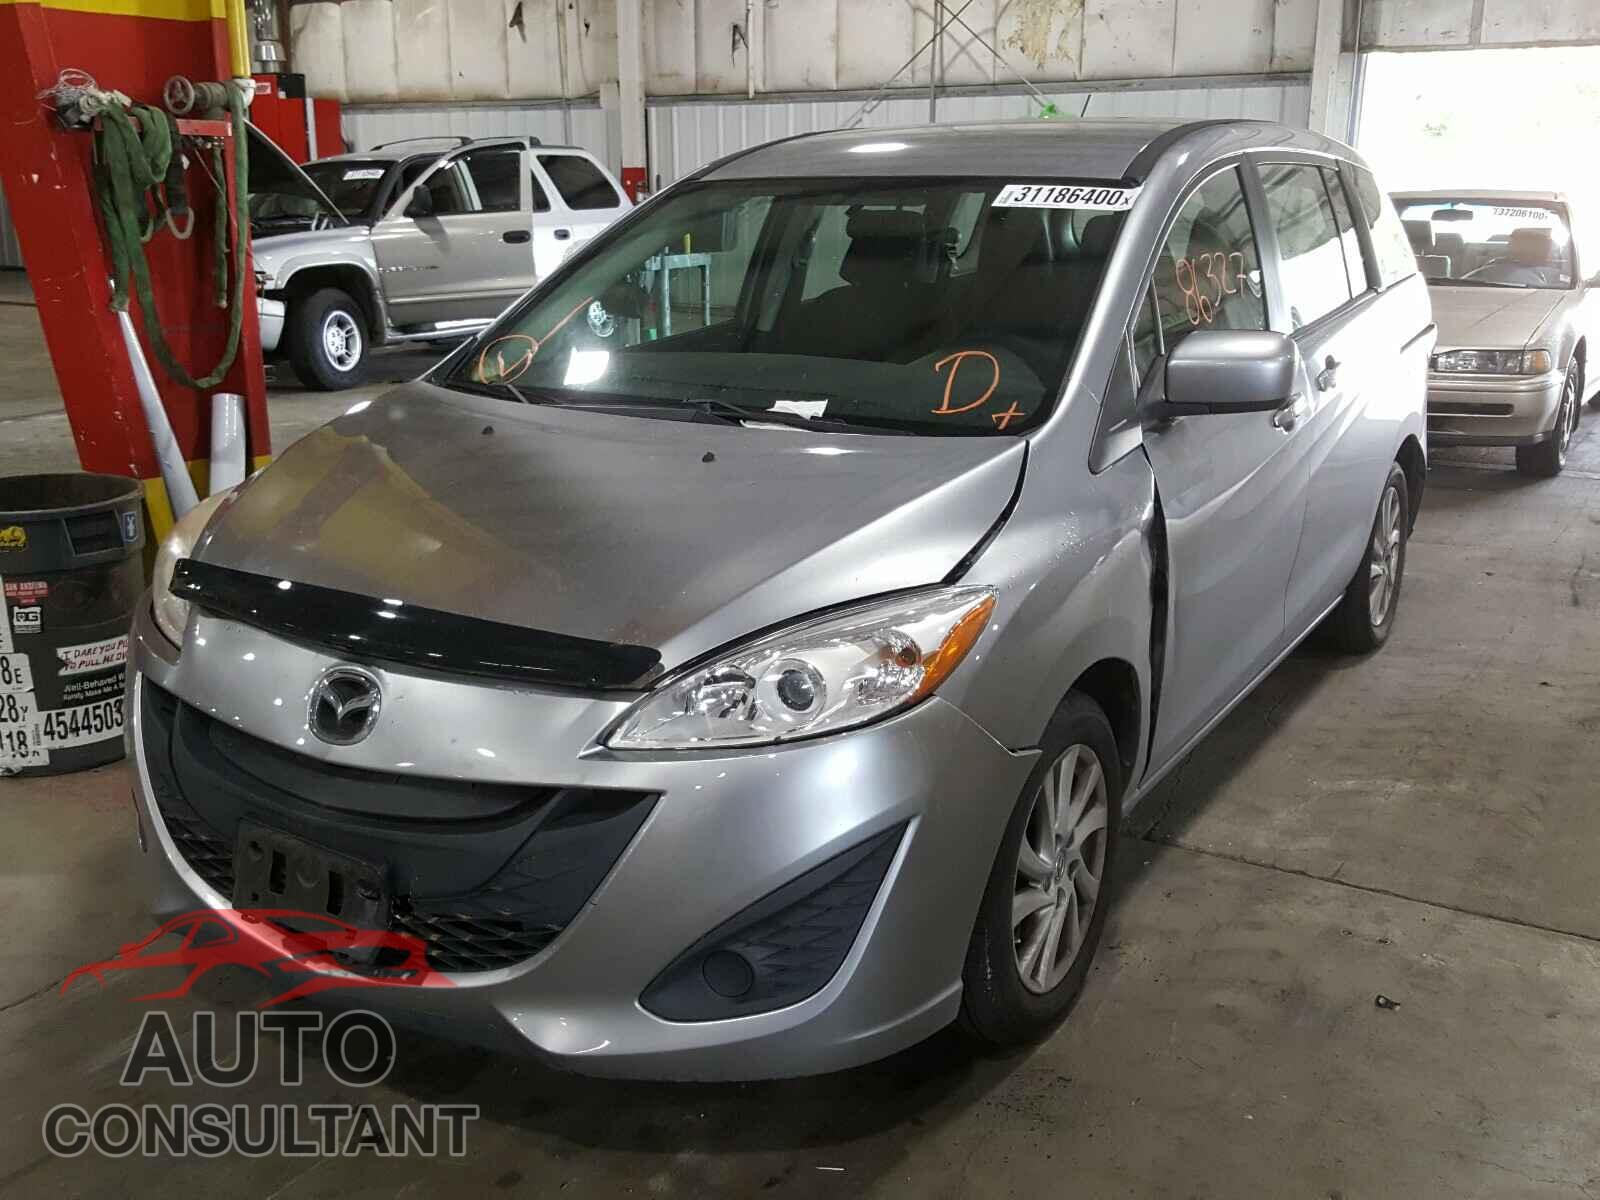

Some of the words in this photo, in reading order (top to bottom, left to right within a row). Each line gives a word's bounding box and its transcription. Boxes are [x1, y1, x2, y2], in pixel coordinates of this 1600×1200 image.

[74, 647, 97, 658] DARE
[97, 641, 116, 654] YOU
[78, 659, 101, 669] PULL
[43, 698, 123, 741] 4544503
